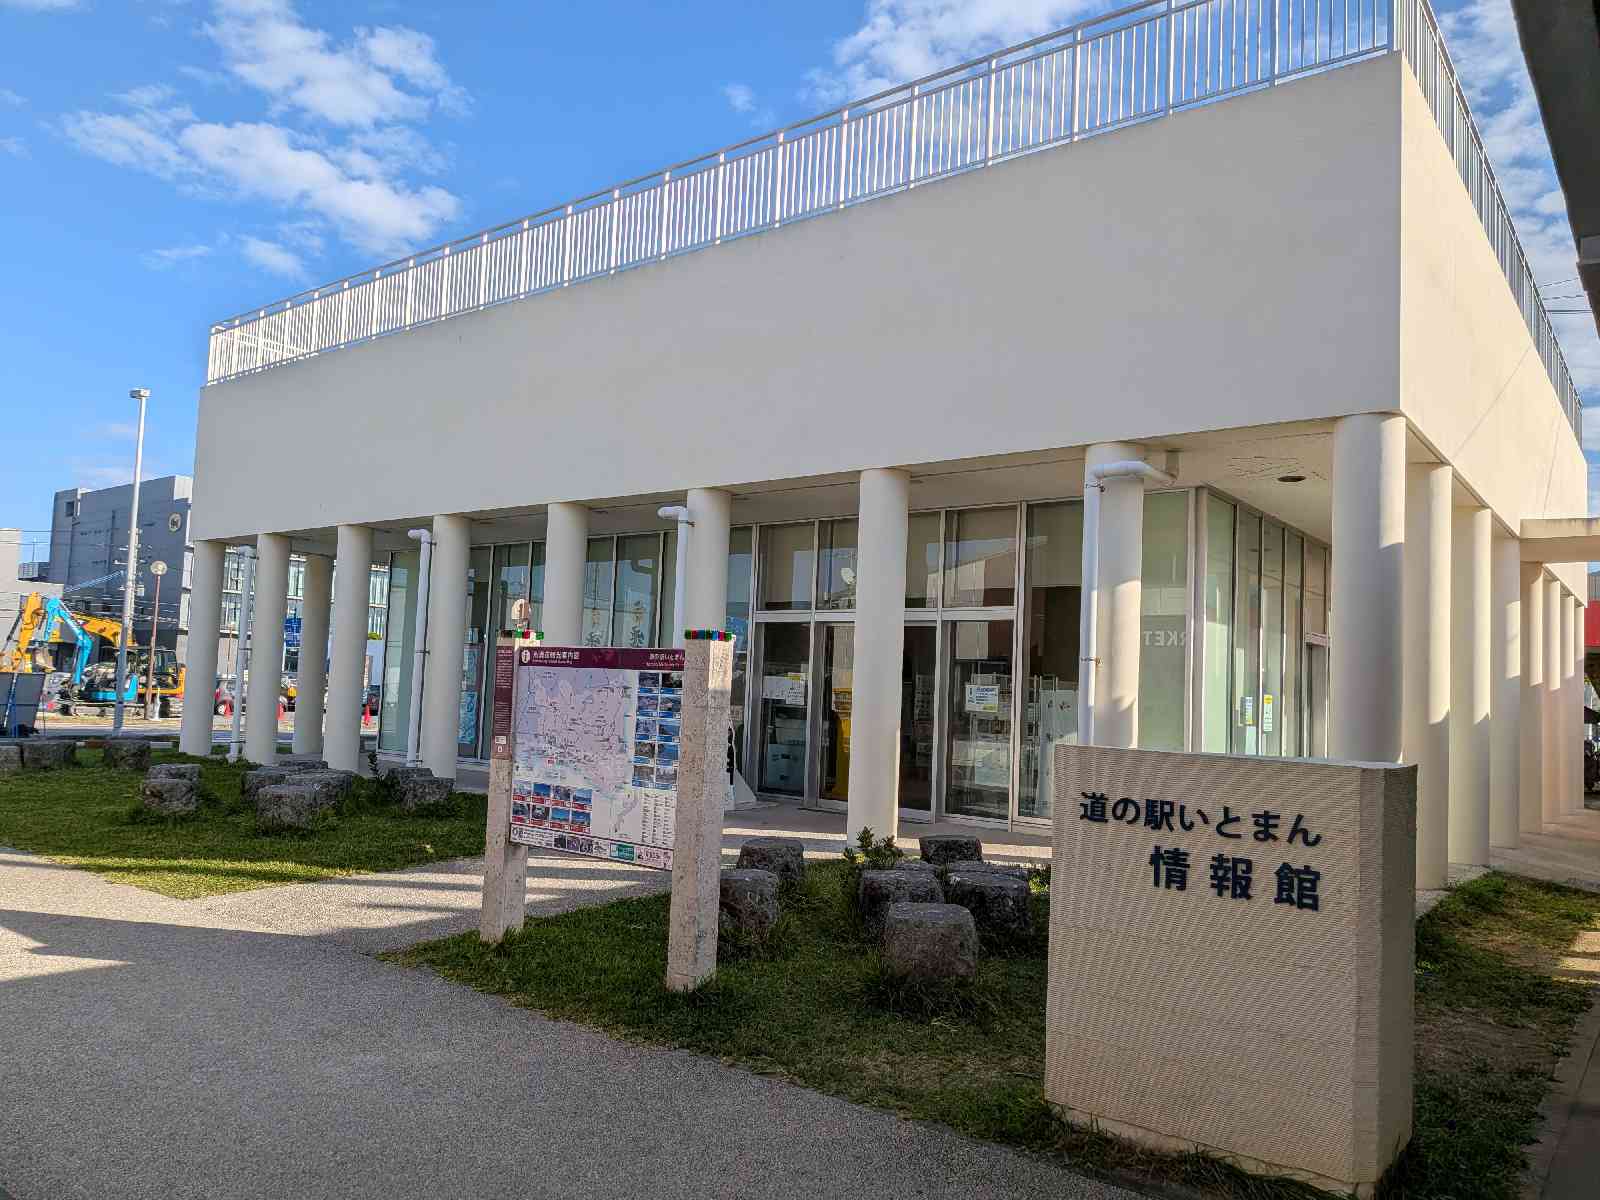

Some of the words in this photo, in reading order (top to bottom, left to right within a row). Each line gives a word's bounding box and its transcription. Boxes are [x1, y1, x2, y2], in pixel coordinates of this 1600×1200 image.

[1079, 791, 1322, 846] 道の駅いとまん
[1149, 845, 1321, 912] 情報館
